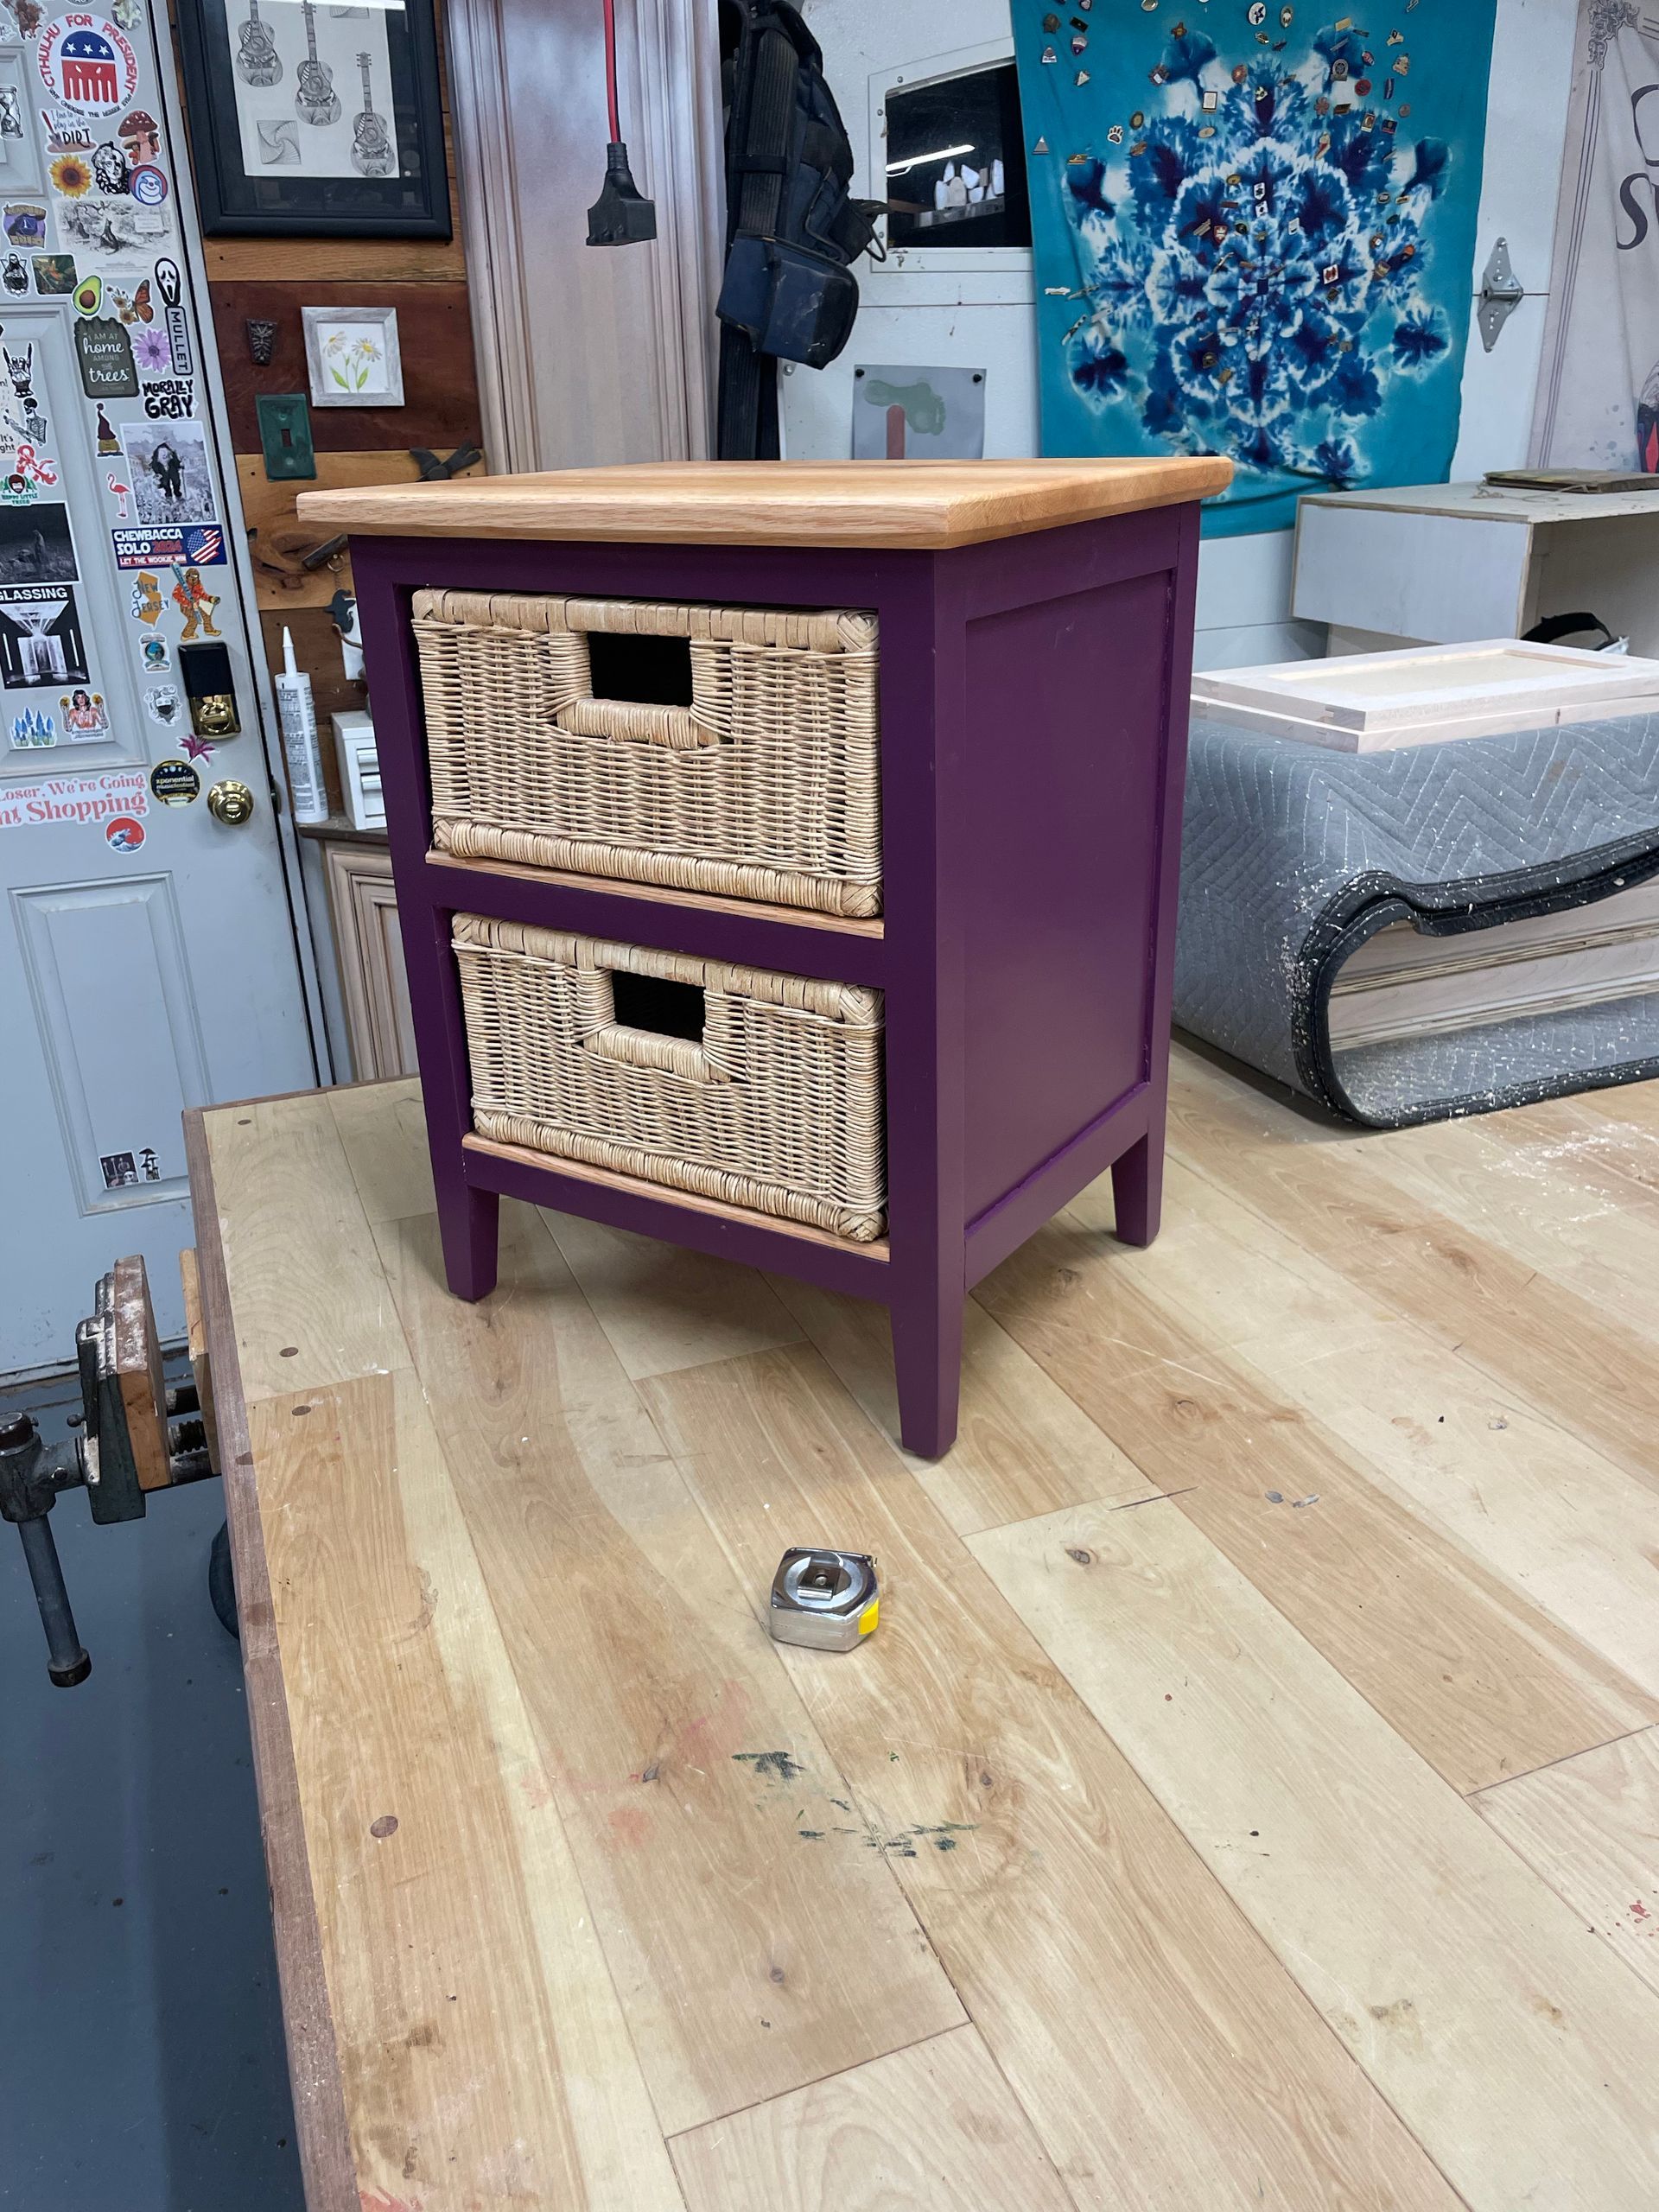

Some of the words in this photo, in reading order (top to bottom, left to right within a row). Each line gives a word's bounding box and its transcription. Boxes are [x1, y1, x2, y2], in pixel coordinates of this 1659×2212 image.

[38, 23, 61, 87] CTHULHU
[65, 14, 94, 27] FOR
[102, 22, 138, 95] PRESIDENT
[62, 128, 91, 149] DIRT
[83, 338, 124, 355] home
[170, 311, 188, 371] MULLET
[142, 379, 194, 397] MORALLY
[144, 395, 193, 419] GRAY
[0, 434, 14, 442] It's
[113, 528, 184, 542] CHEWBACCA
[117, 542, 151, 556] SOLO
[152, 540, 182, 553] 2024
[132, 580, 159, 600] NEW
[131, 600, 169, 618] JERSEY
[48, 780, 97, 796] We're
[99, 773, 146, 790] Going
[156, 775, 194, 785] xponential
[26, 789, 148, 823] Shopping
